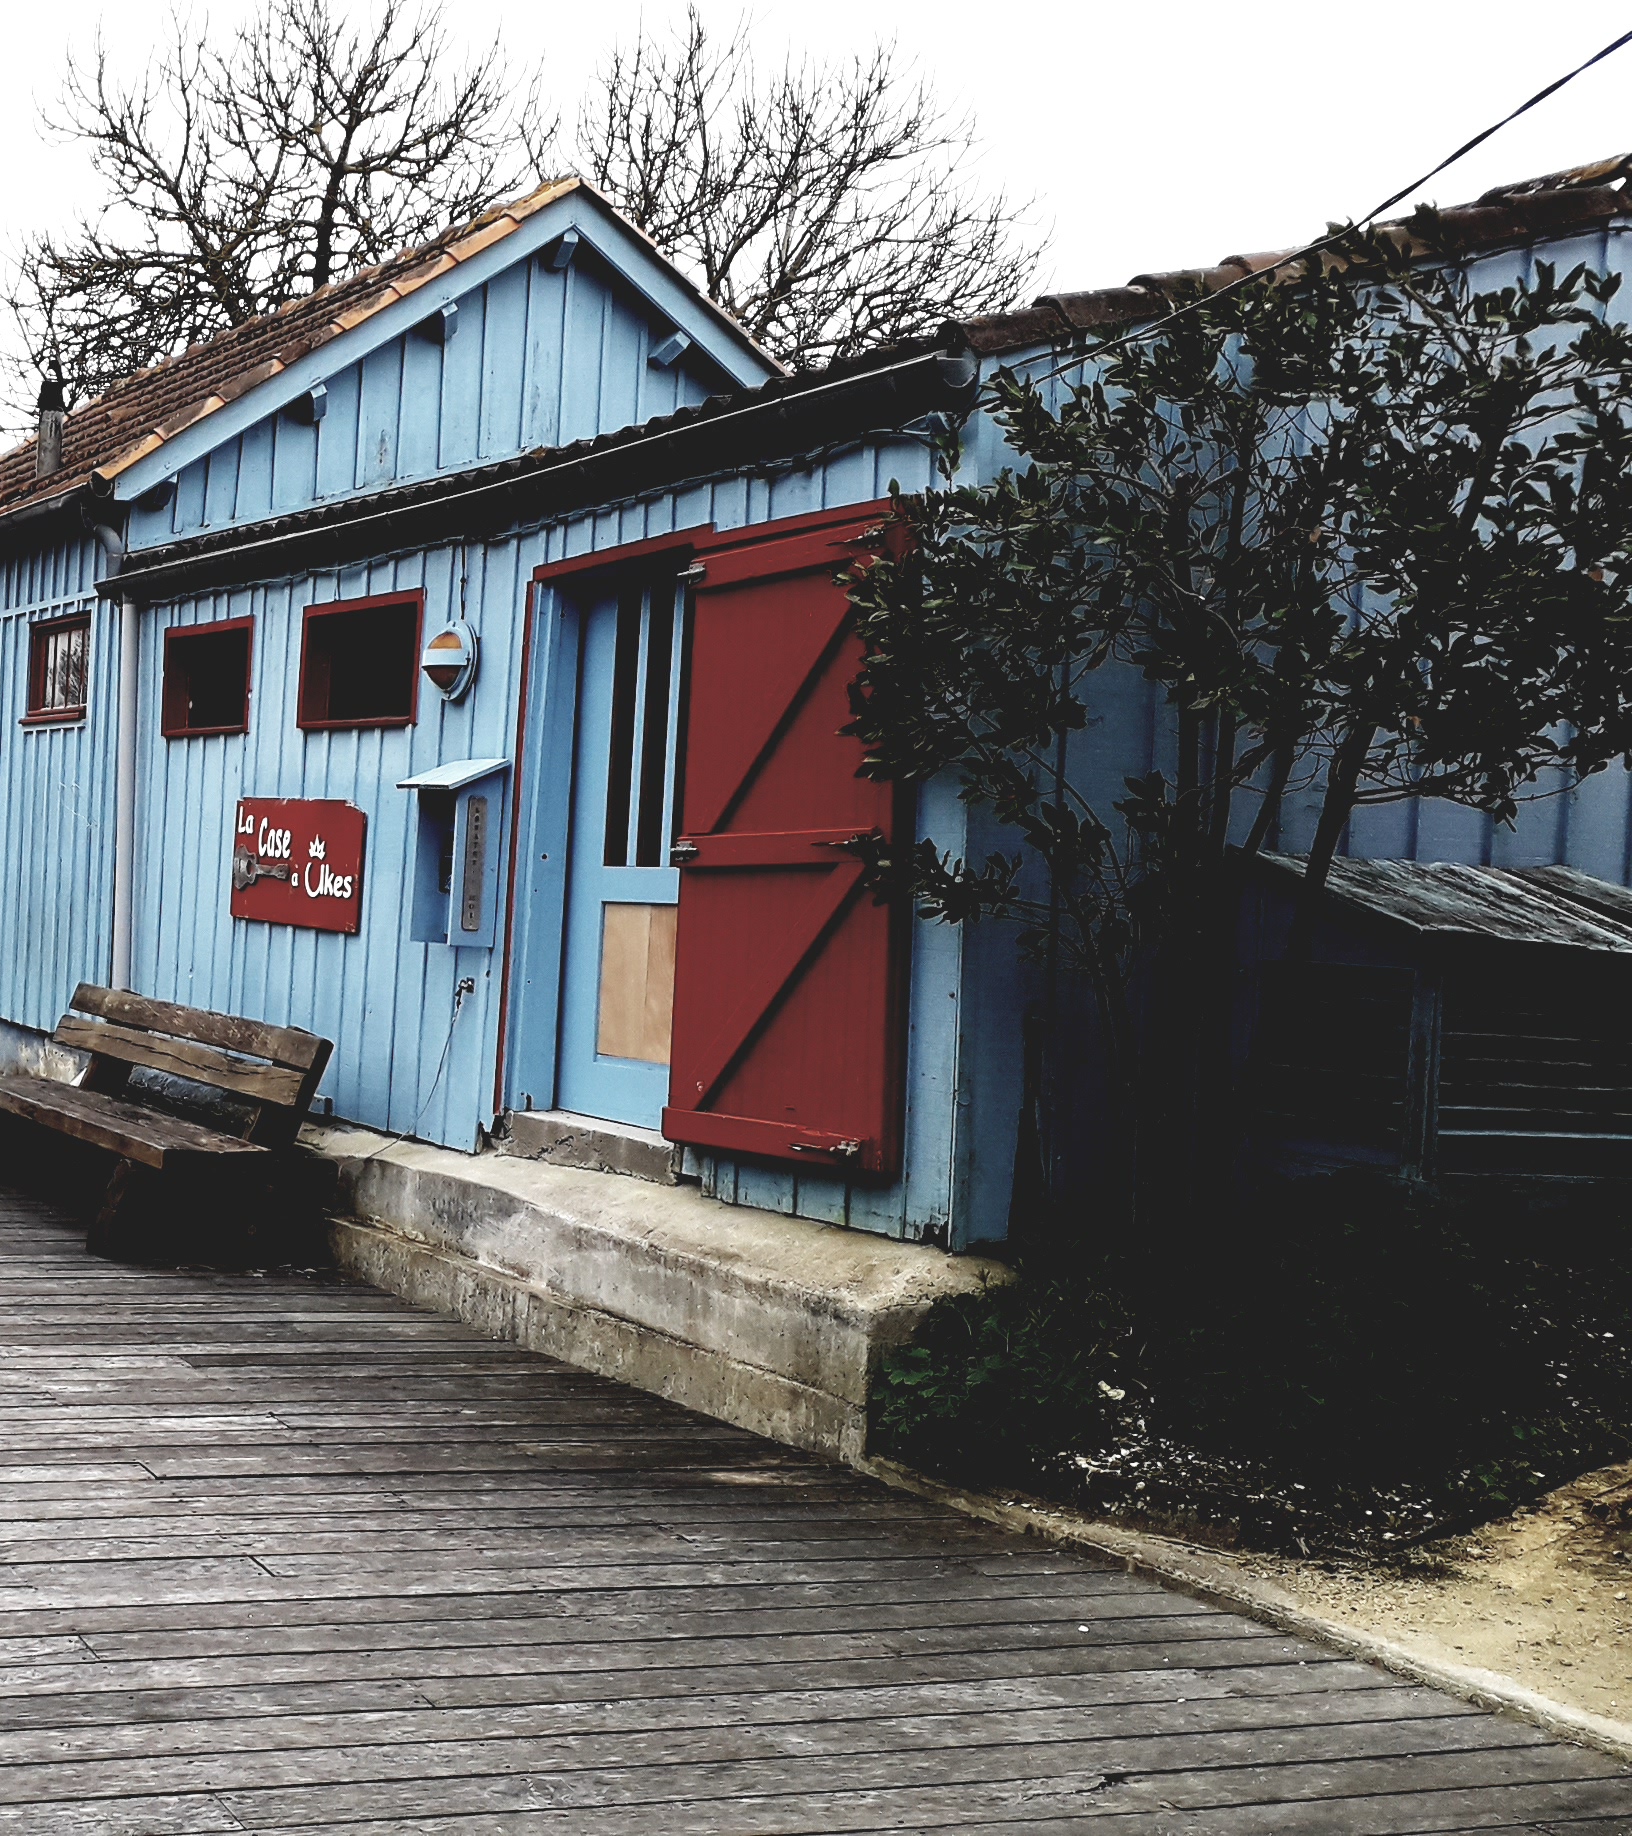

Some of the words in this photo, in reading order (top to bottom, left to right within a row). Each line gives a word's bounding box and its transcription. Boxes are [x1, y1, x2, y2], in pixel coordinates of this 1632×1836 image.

[237, 805, 255, 834] La
[258, 817, 292, 859] Case
[291, 863, 299, 887] à
[304, 862, 353, 898] Ukes
